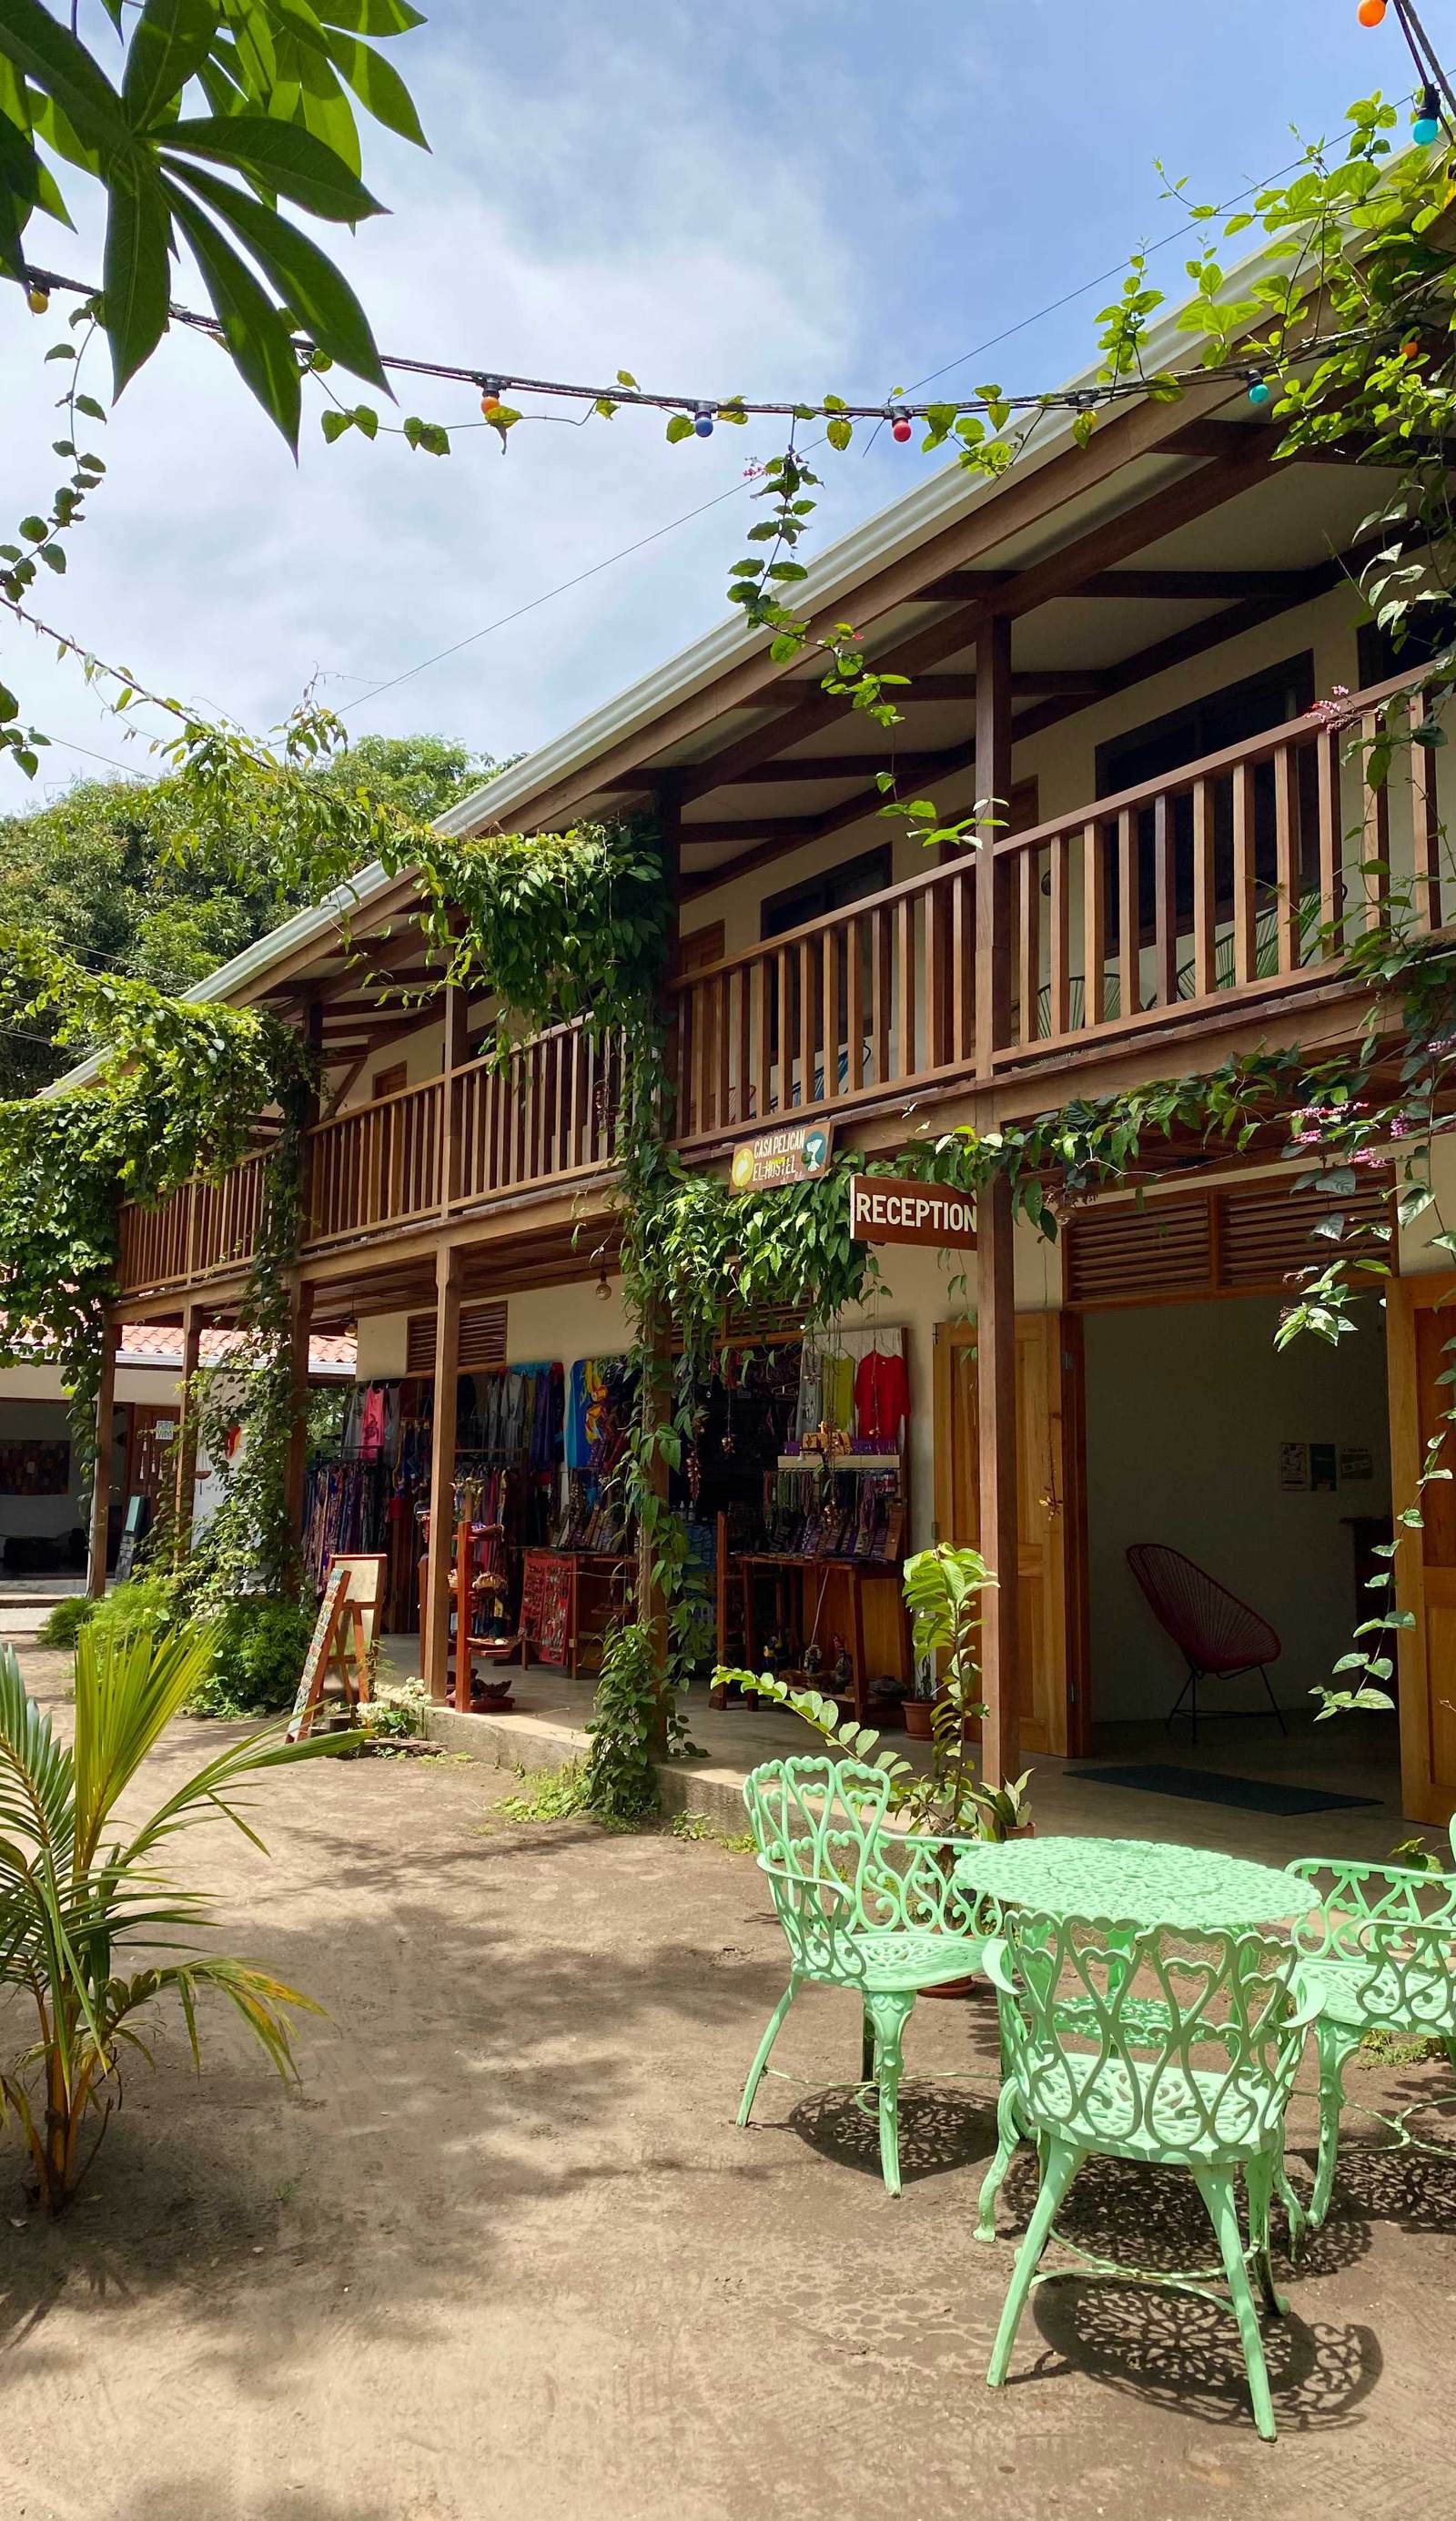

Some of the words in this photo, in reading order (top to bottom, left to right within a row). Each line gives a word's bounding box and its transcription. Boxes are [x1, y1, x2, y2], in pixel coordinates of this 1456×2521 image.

[753, 1137, 772, 1159] CASA
[773, 1129, 805, 1155] PELICAN
[753, 1162, 763, 1181] EL
[764, 1155, 796, 1180] HOSTEL
[856, 1192, 976, 1232] RECEPTION
